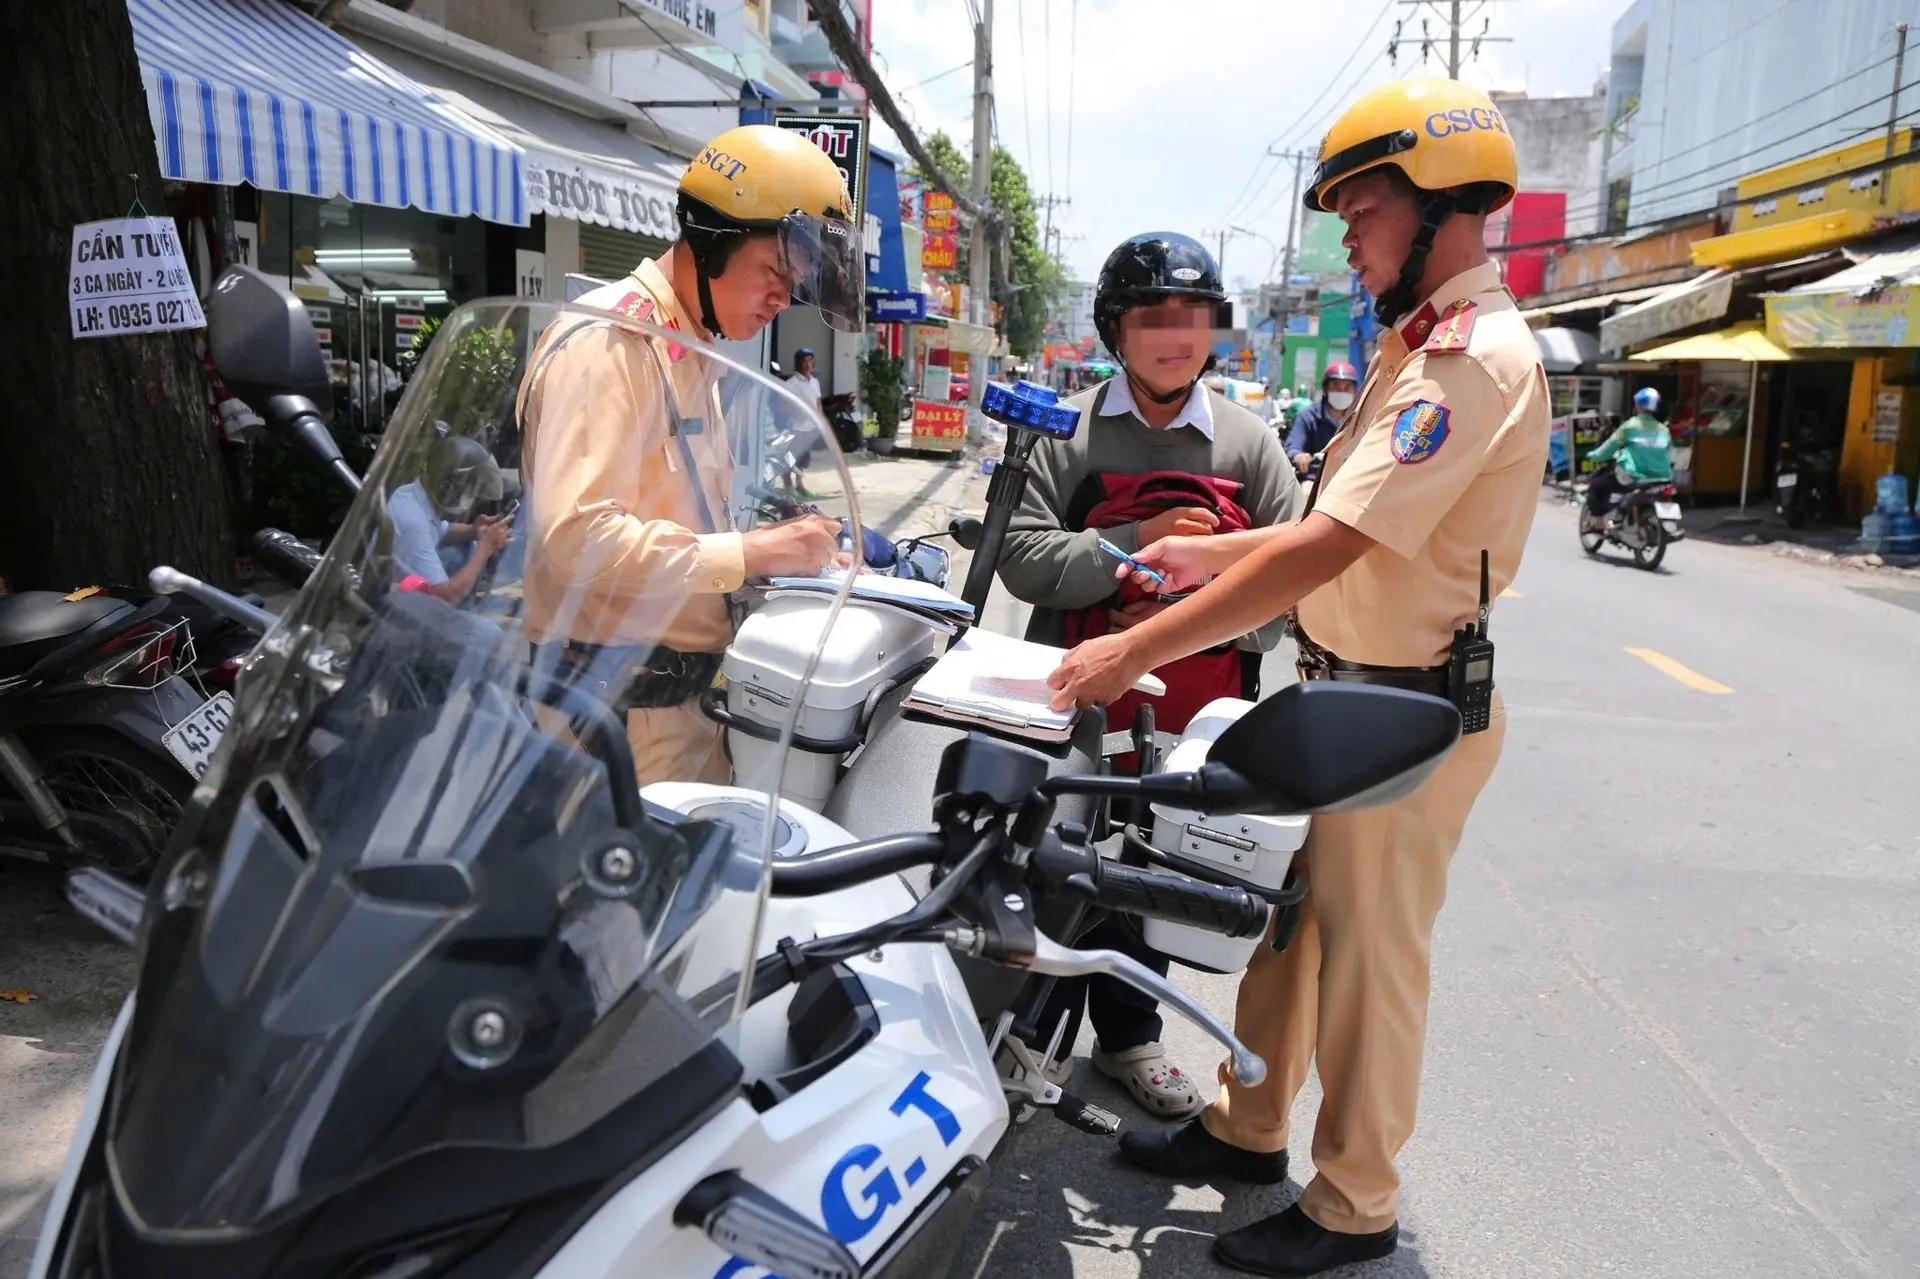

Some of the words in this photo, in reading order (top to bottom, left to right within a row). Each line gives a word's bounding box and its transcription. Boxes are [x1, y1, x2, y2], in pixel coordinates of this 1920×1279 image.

[1425, 107, 1506, 138] CSGT
[782, 124, 853, 158] ỚT
[695, 146, 747, 181] SGT
[545, 165, 606, 216] HỚT
[614, 184, 664, 229] TÓC
[78, 228, 125, 263] CẦN
[73, 277, 82, 295] 3
[85, 274, 103, 294] CA
[106, 268, 143, 292] NGÀY
[156, 270, 166, 288] 2
[76, 306, 105, 332] LH:
[108, 302, 153, 329] 0935
[157, 300, 185, 325] 027
